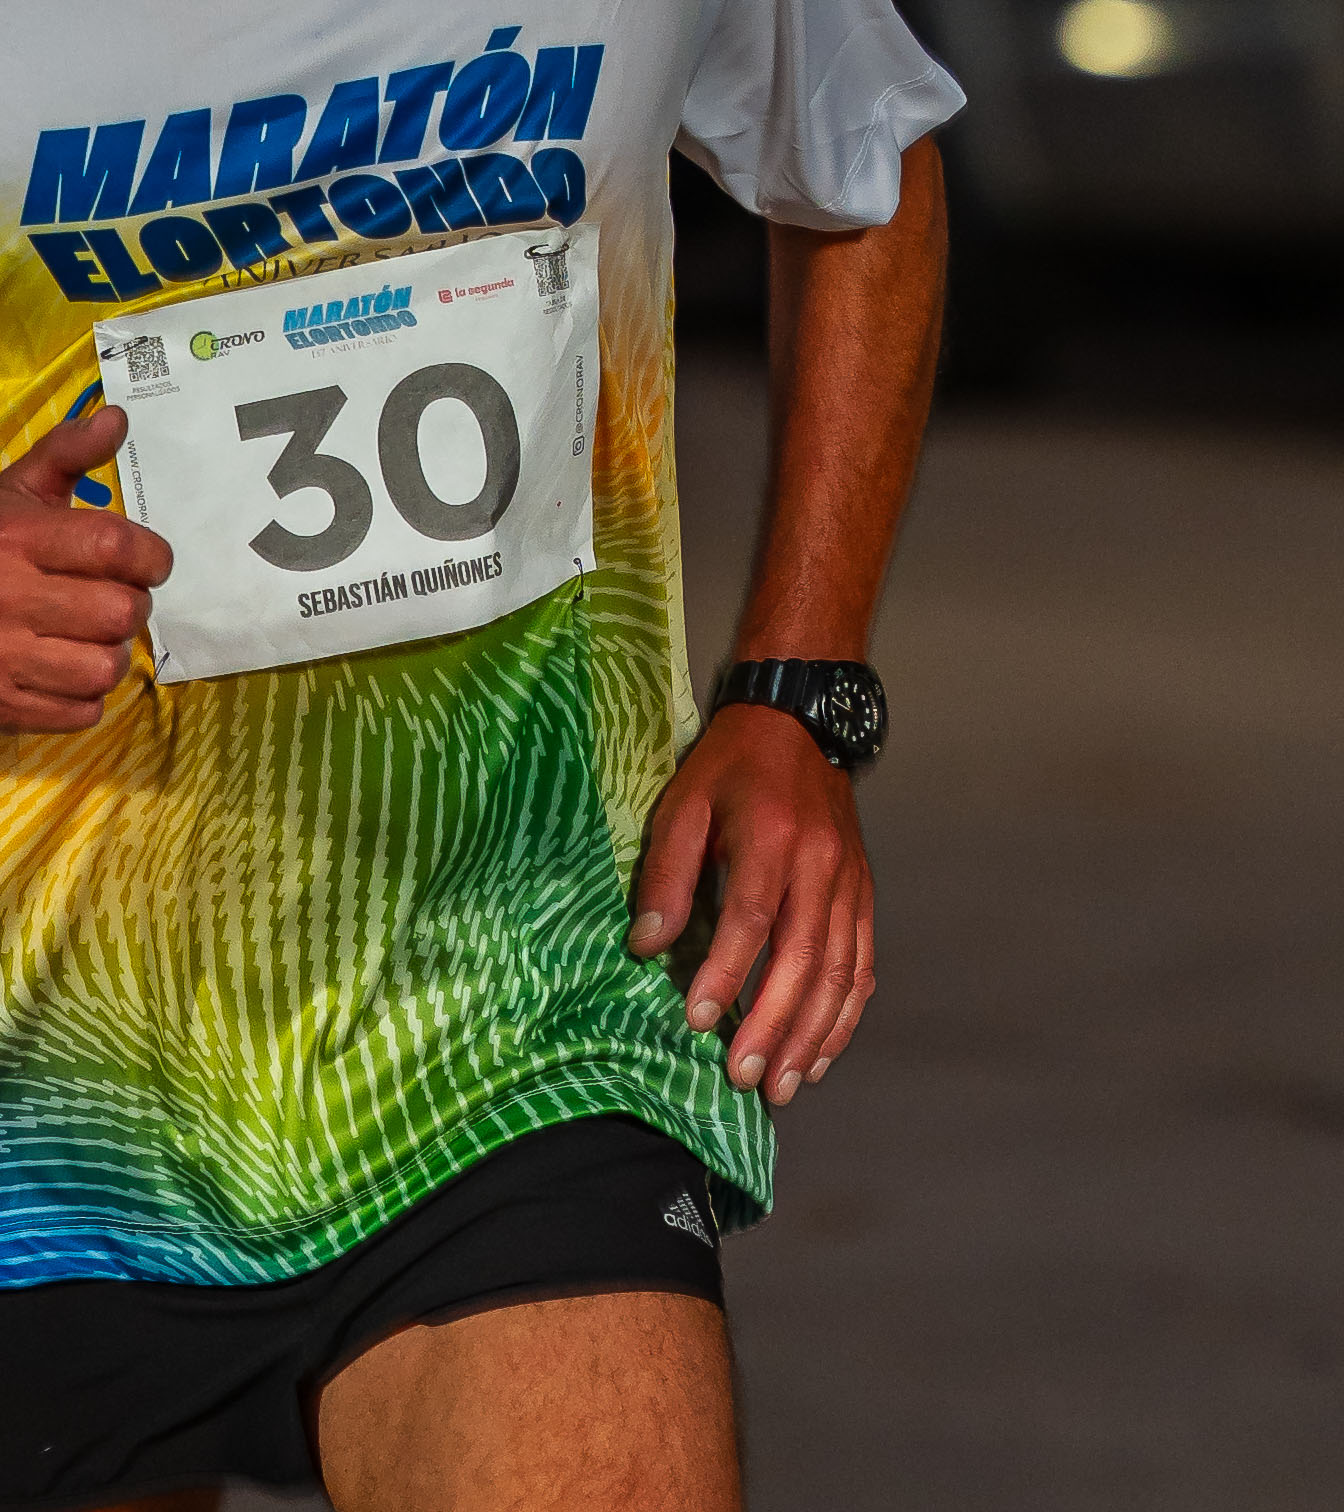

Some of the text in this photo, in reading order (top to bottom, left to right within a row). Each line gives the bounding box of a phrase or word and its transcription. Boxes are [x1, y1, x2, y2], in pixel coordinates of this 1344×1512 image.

[20, 25, 605, 226] MARATÓN
[28, 147, 587, 304] ELORTONDO
[210, 330, 266, 352] CRONO
[283, 284, 413, 333] MARATÓN
[284, 310, 418, 350] ELORTONDO
[234, 363, 522, 573] 30
[297, 551, 504, 619] SEBASTIÁN QUIÑONES
